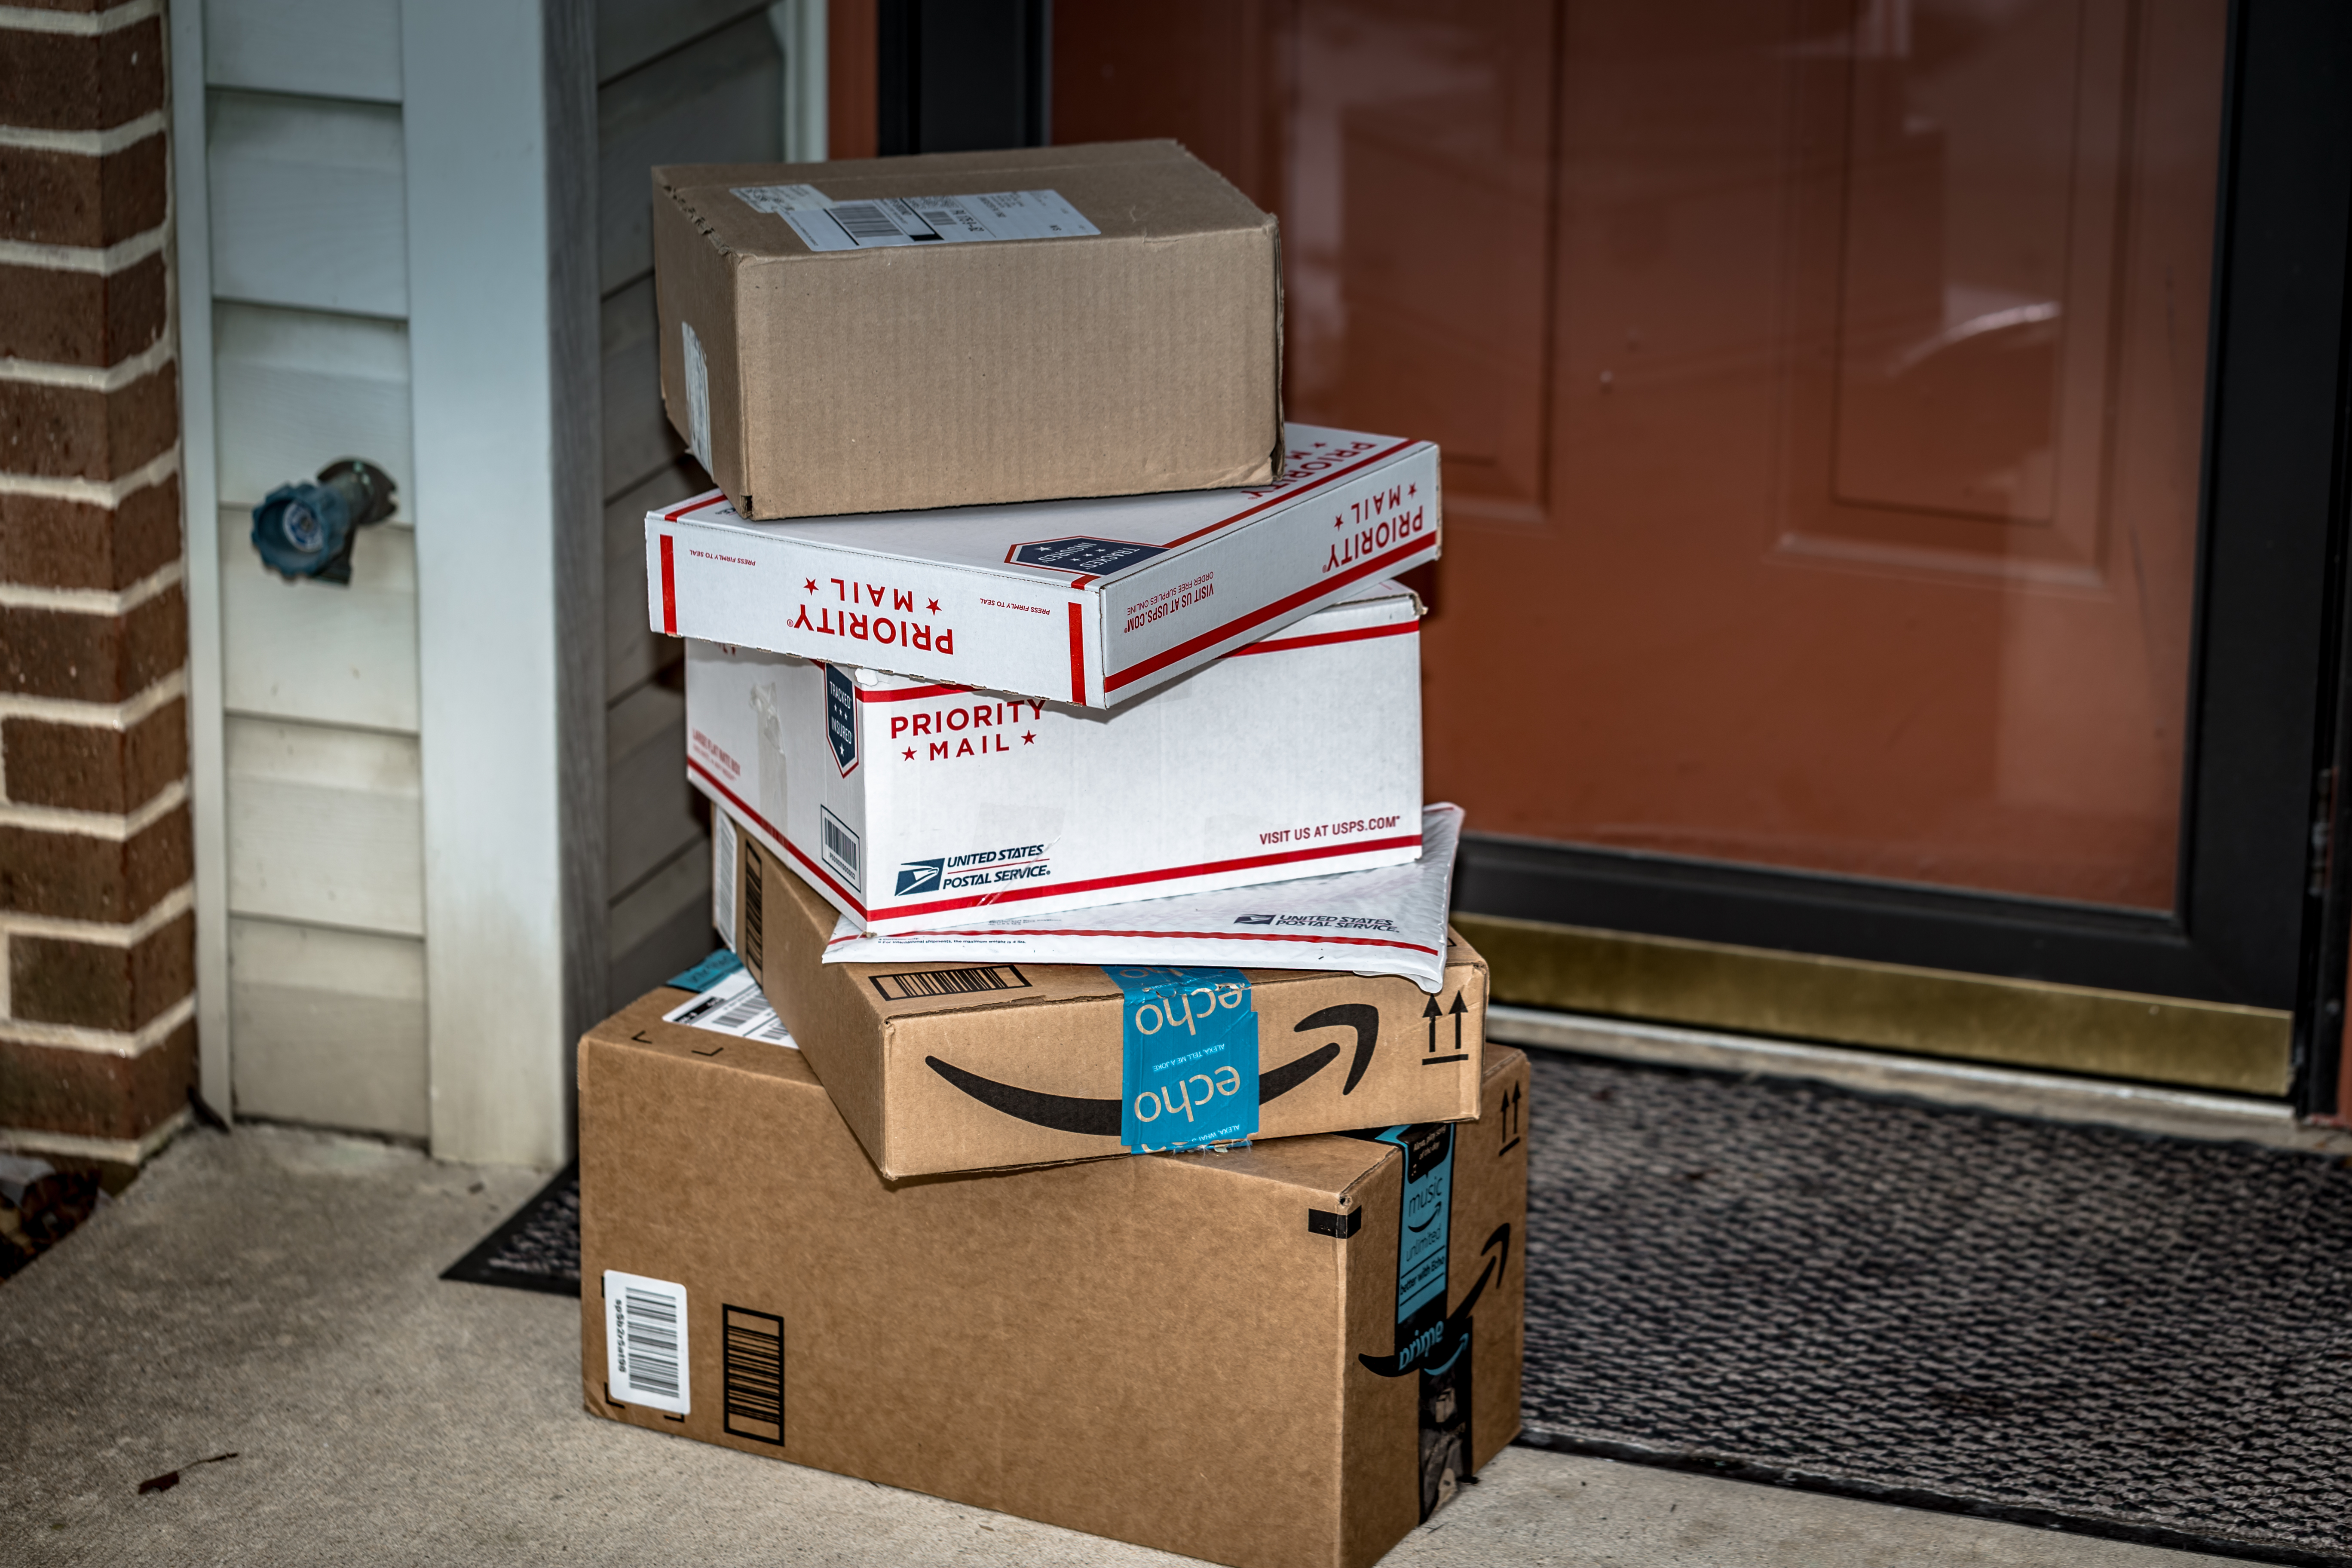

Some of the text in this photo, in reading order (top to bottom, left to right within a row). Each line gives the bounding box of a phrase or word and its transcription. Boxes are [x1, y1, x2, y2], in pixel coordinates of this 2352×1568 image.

[1351, 484, 1401, 524] MAIL
[714, 554, 736, 563] FIRMLY
[737, 558, 756, 566] PRESS
[831, 578, 913, 612] MAIL
[1127, 571, 1214, 616] ORDER FREE SUPPLIES ONLINE
[1182, 592, 1192, 608] US
[1194, 583, 1214, 603] VISIT
[1006, 603, 1029, 611] FIRMLY
[1030, 606, 1050, 615] PRESS
[1170, 597, 1180, 613] AT
[891, 698, 1046, 739] PRIORITY
[929, 734, 1009, 761] MAIL
[1260, 830, 1290, 845] VISIT
[1294, 827, 1311, 840] US
[1314, 825, 1329, 838] AT
[947, 844, 1044, 867] UNITED STATES
[943, 873, 992, 889] POSTAL
[1339, 917, 1393, 925] STATES
[1135, 988, 1242, 1036] echo
[1187, 1051, 1203, 1060] TELL
[1203, 1044, 1225, 1054] ALEXA,
[1153, 1061, 1170, 1072] JOKE
[1134, 1066, 1240, 1123] echo
[1218, 1124, 1240, 1135] ALEXA,
[1409, 1176, 1442, 1217] music
[1406, 1223, 1441, 1262] unlimited
[1400, 1256, 1445, 1295] better with Echo
[1398, 1320, 1444, 1371] prime
